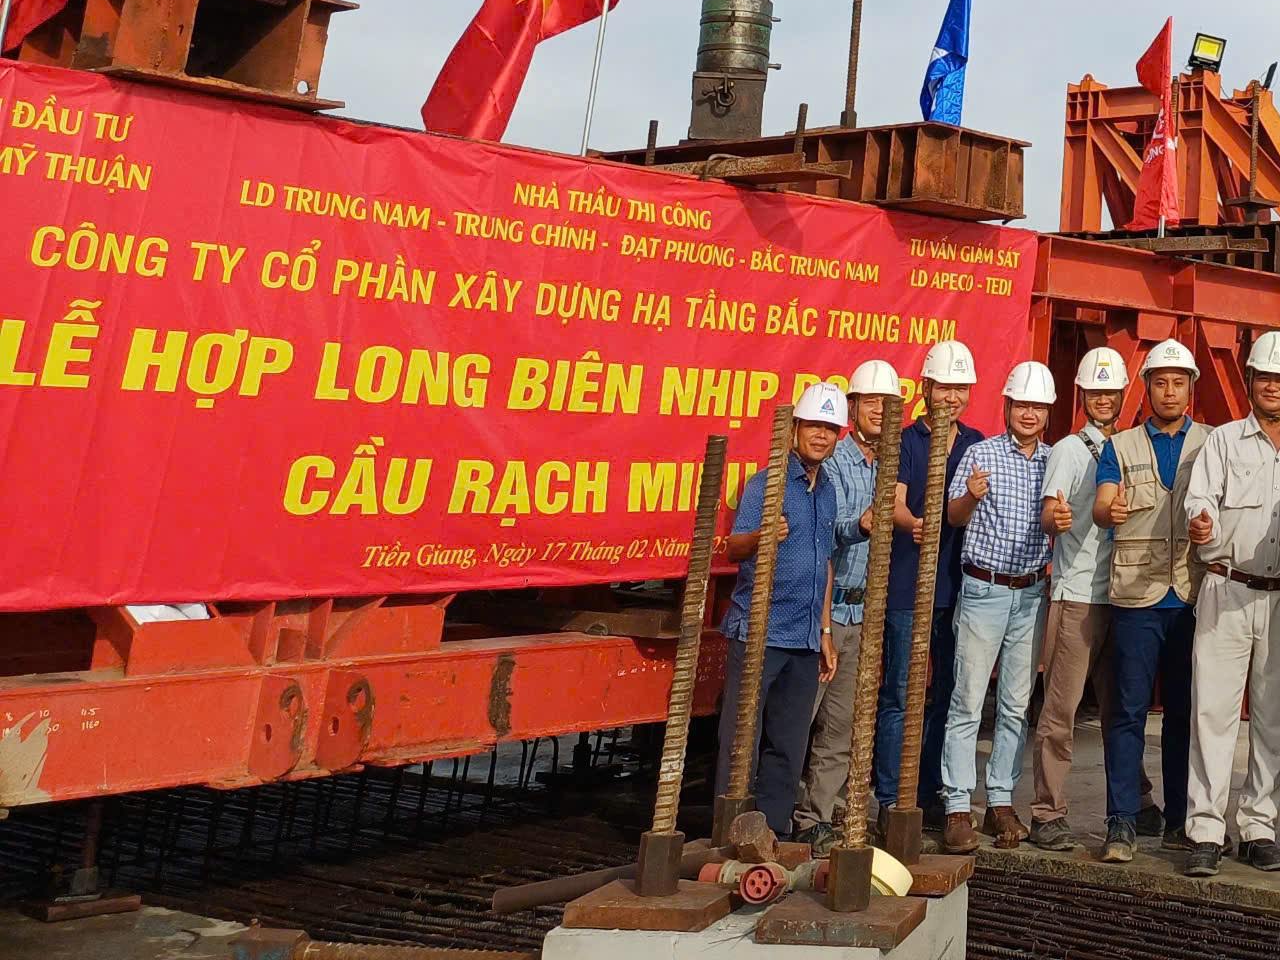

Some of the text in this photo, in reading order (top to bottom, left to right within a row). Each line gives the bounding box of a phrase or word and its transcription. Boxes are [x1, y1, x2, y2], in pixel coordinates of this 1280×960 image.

[12, 95, 83, 135] ĐẦU
[93, 113, 133, 141] TƯ
[45, 152, 151, 193] THUẬN
[513, 181, 712, 230] NHÀ THẦU THI CÔNG
[240, 180, 274, 206] LD
[284, 186, 366, 220] TRUNG
[373, 201, 430, 230] NAM
[455, 212, 523, 242] TRUNG
[531, 221, 596, 250] CHÍNH
[621, 235, 661, 261] ĐẠT
[664, 240, 734, 267] PHƯƠNG
[750, 244, 785, 273] BẮC
[790, 256, 840, 279] TRUNG
[845, 262, 879, 282] NAM
[911, 236, 1021, 269] TƯ VẤN GIÁM SÁT
[31, 222, 955, 344] CÔNG TY CỔ PHẦN XÂY DỰNG HẠ TẦNG BẮC TRUNG NAM
[911, 270, 928, 287] LD
[931, 272, 973, 291] APECO
[986, 277, 1012, 296] TEDI
[0, 299, 102, 388] LỄ
[121, 328, 293, 408] HỢP
[315, 342, 490, 408] LONG
[507, 351, 643, 414] BIÊN
[660, 367, 779, 428] NHỊP
[283, 436, 757, 526] CẦU RẠCH MIU
[360, 535, 730, 569] Tiền Giang, Ngày 17 Tháng 02 Năm 25
